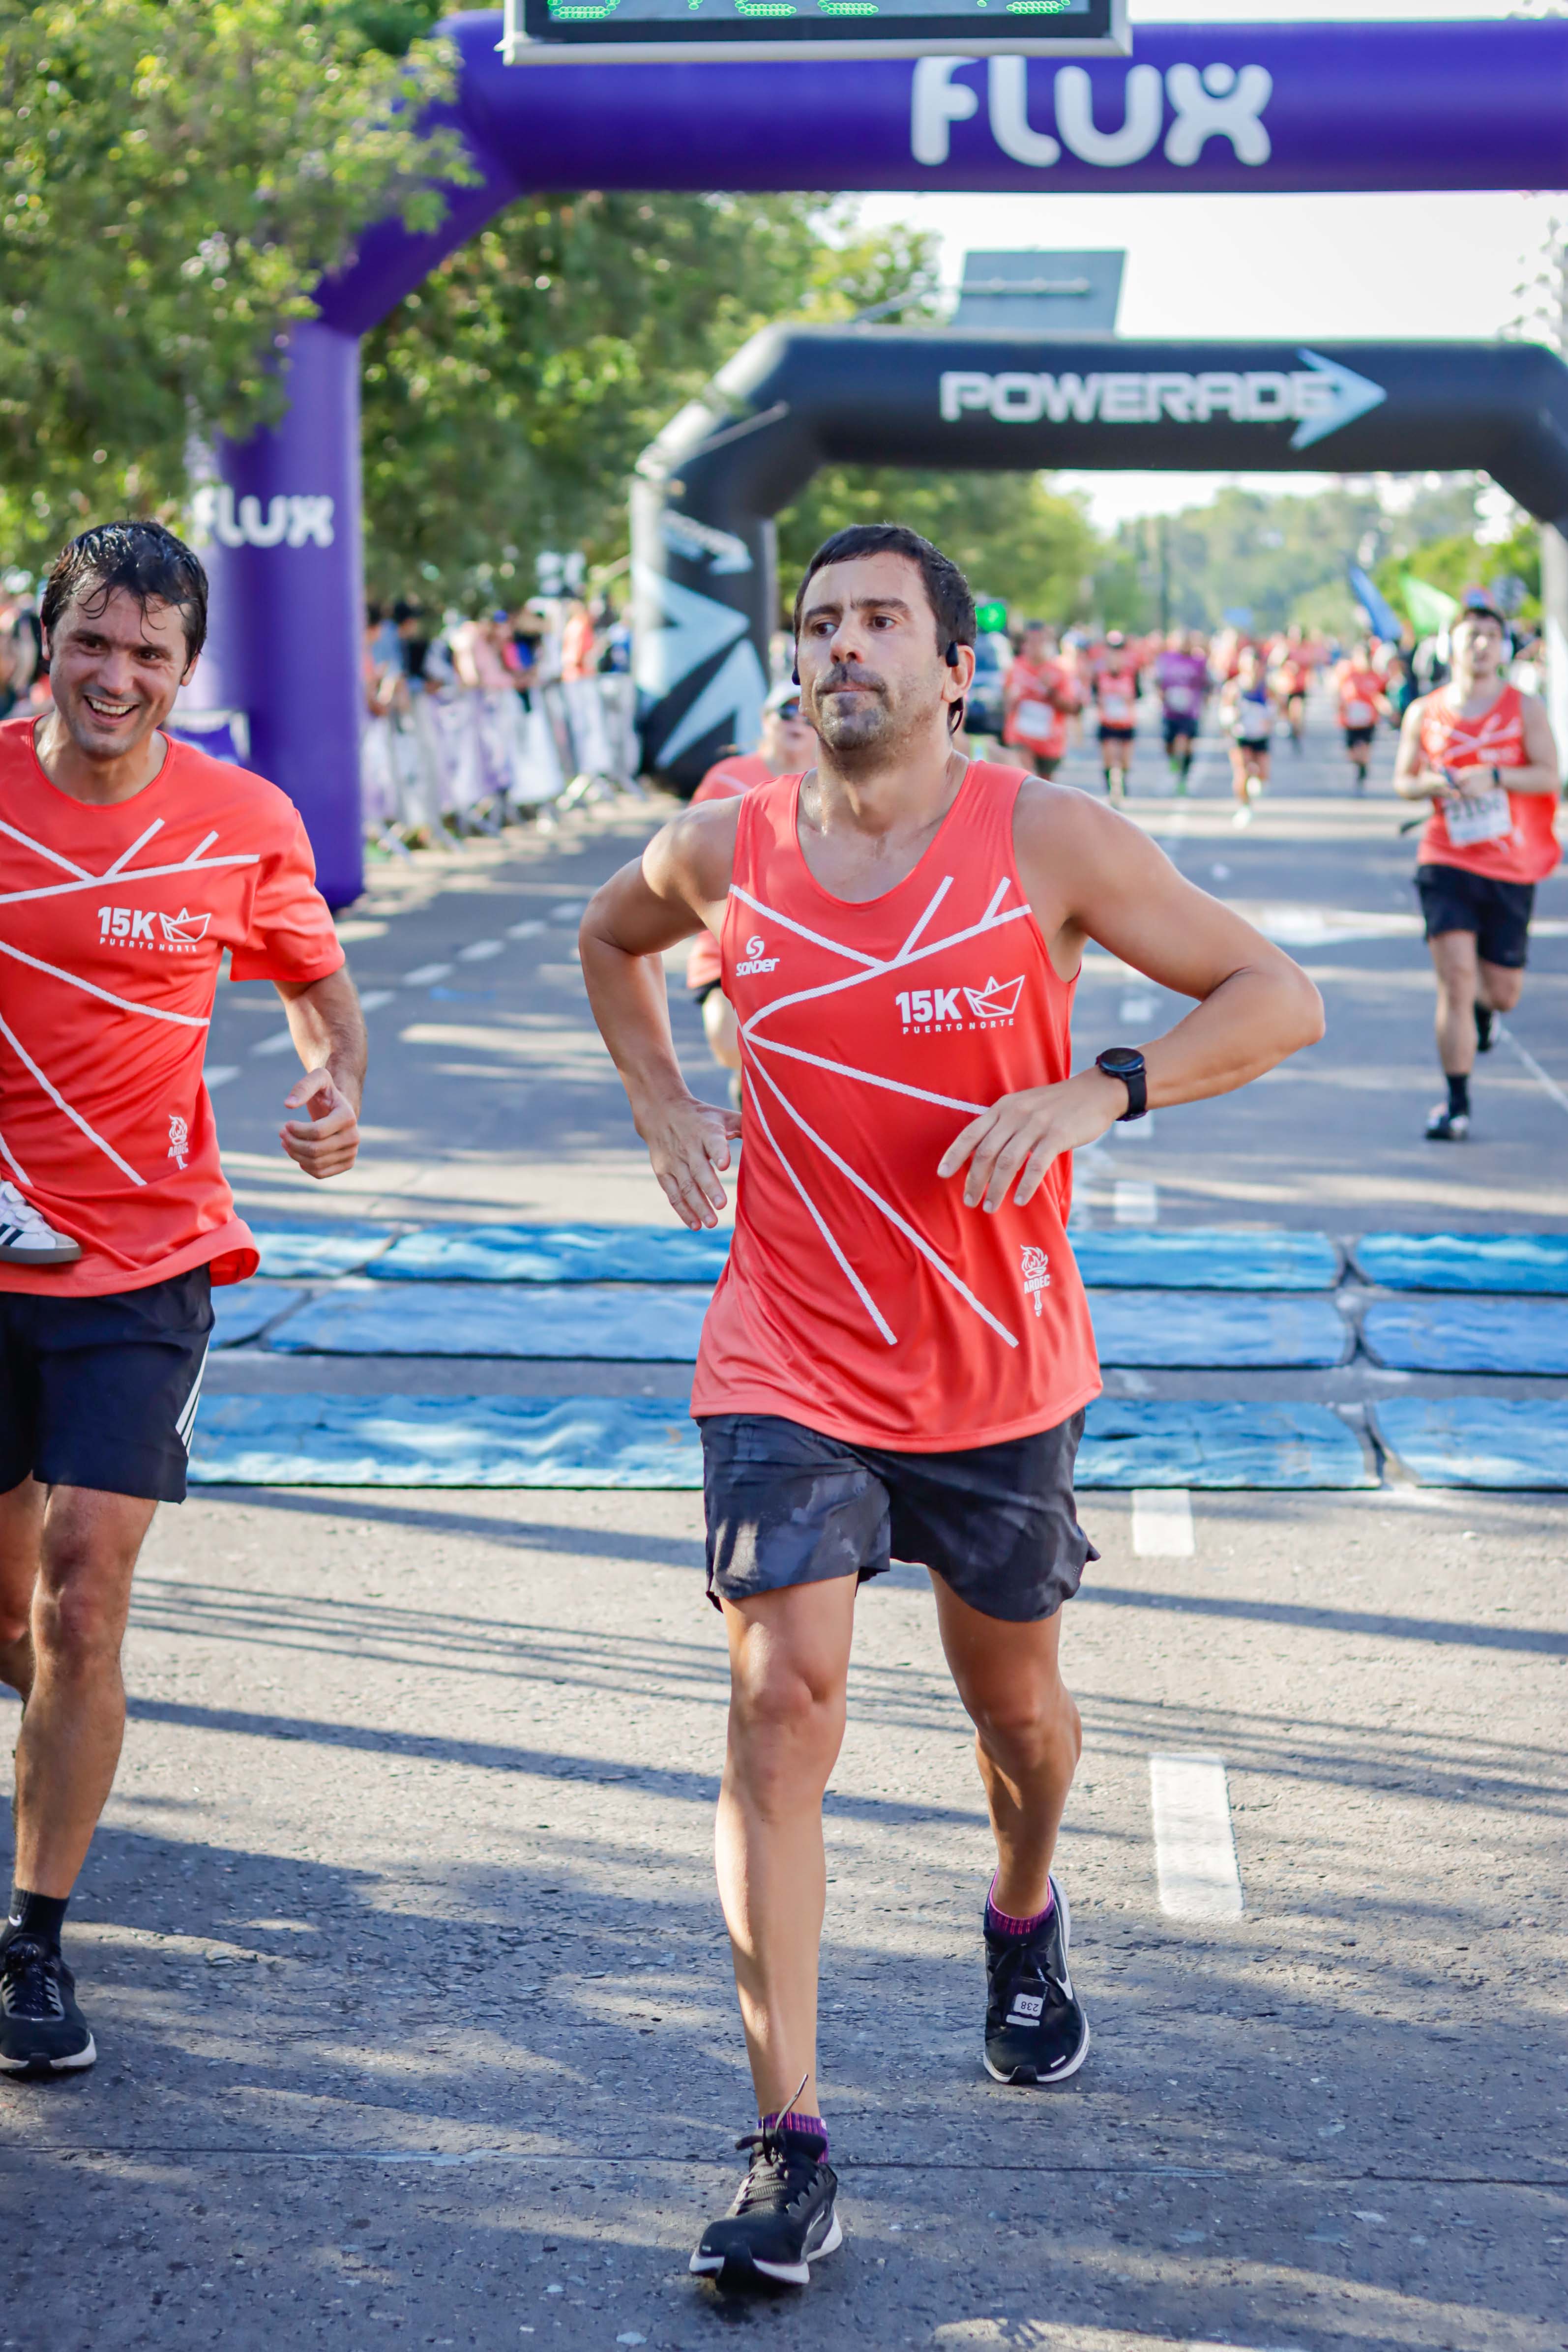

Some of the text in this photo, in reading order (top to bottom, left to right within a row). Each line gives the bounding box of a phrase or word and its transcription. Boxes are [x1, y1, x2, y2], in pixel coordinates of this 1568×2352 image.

[940, 370, 1338, 423] POWERADE
[98, 906, 157, 940] 15K
[100, 937, 196, 952] PUERTO NORTE
[895, 987, 962, 1024] 15K
[903, 1018, 1014, 1035] PUERTO NORTE
[1024, 1274, 1051, 1294] ARDEC
[1020, 2001, 1039, 2012] 238
